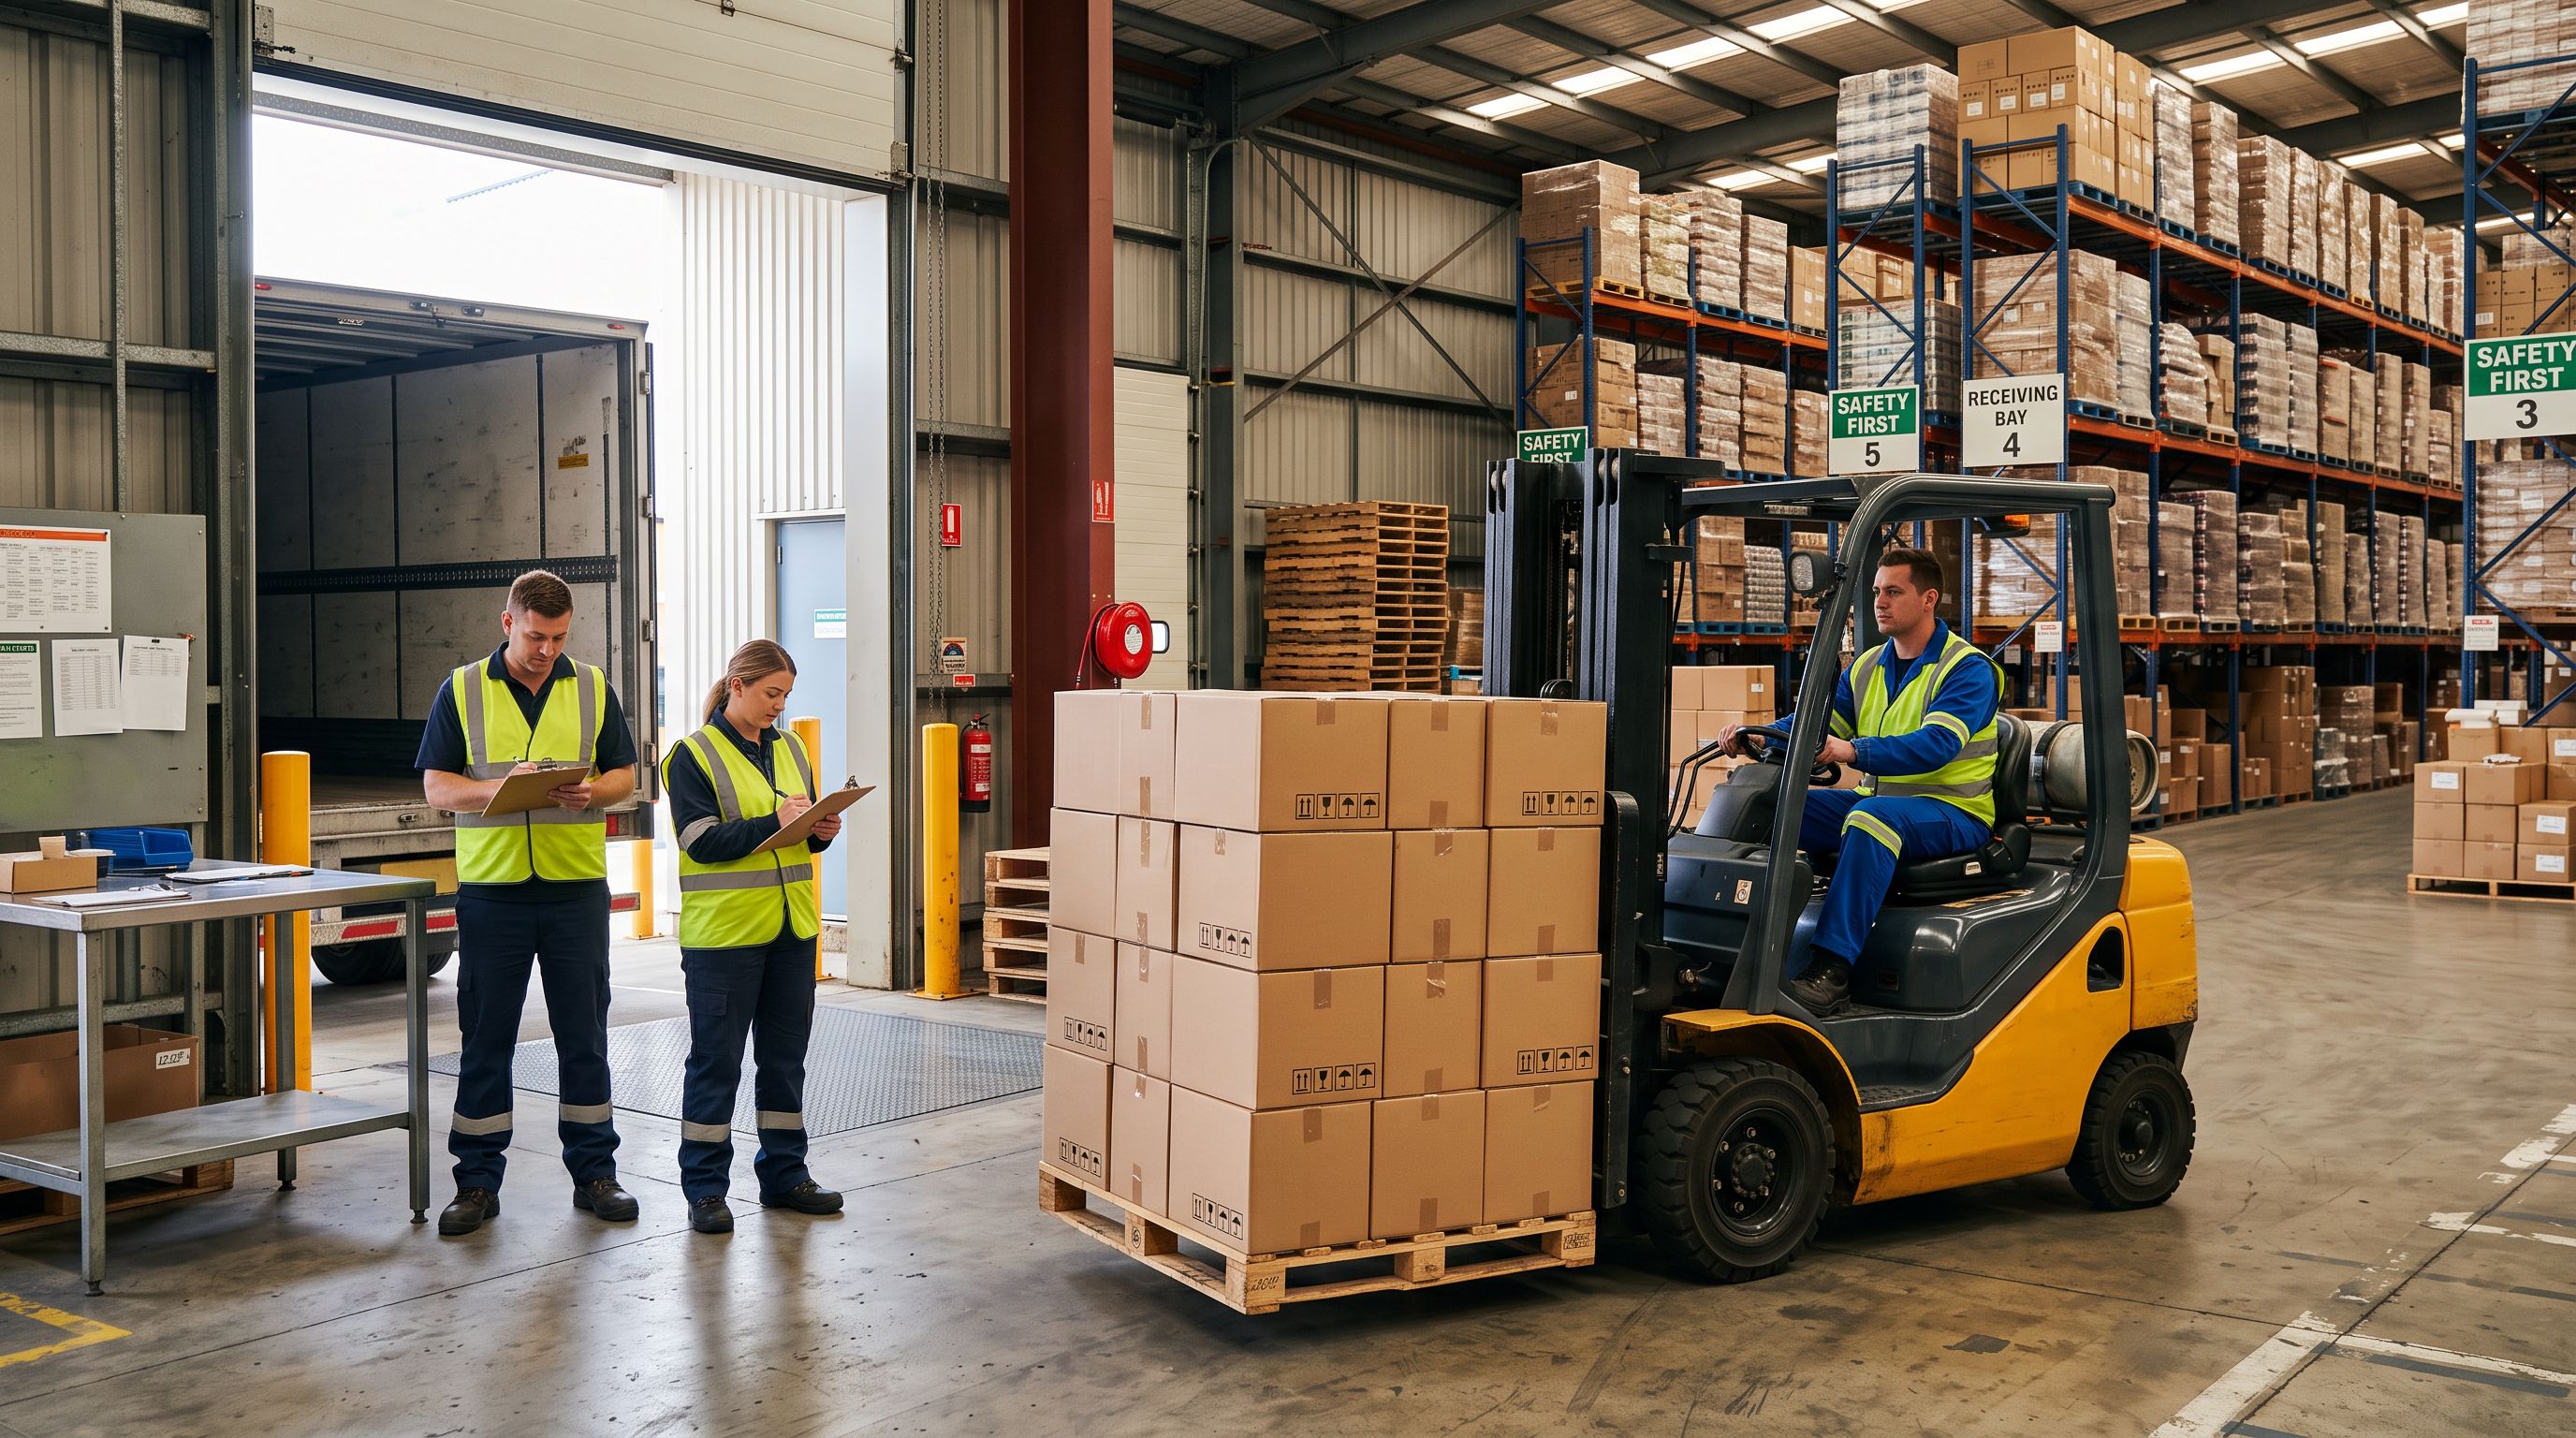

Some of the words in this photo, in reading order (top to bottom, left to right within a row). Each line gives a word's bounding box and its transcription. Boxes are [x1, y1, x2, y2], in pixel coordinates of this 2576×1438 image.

[2477, 340, 2576, 368] SAFETY
[2490, 366, 2565, 392] FIRST
[1837, 392, 1910, 415] SAFETY
[1969, 385, 2058, 406] RECEIVING
[1847, 415, 1900, 435] FIRST
[1995, 409, 2027, 426] BAY
[2515, 399, 2539, 430] 3
[1523, 433, 1581, 451] SAFETY
[1865, 441, 1881, 467] 5
[2002, 432, 2021, 458] 4
